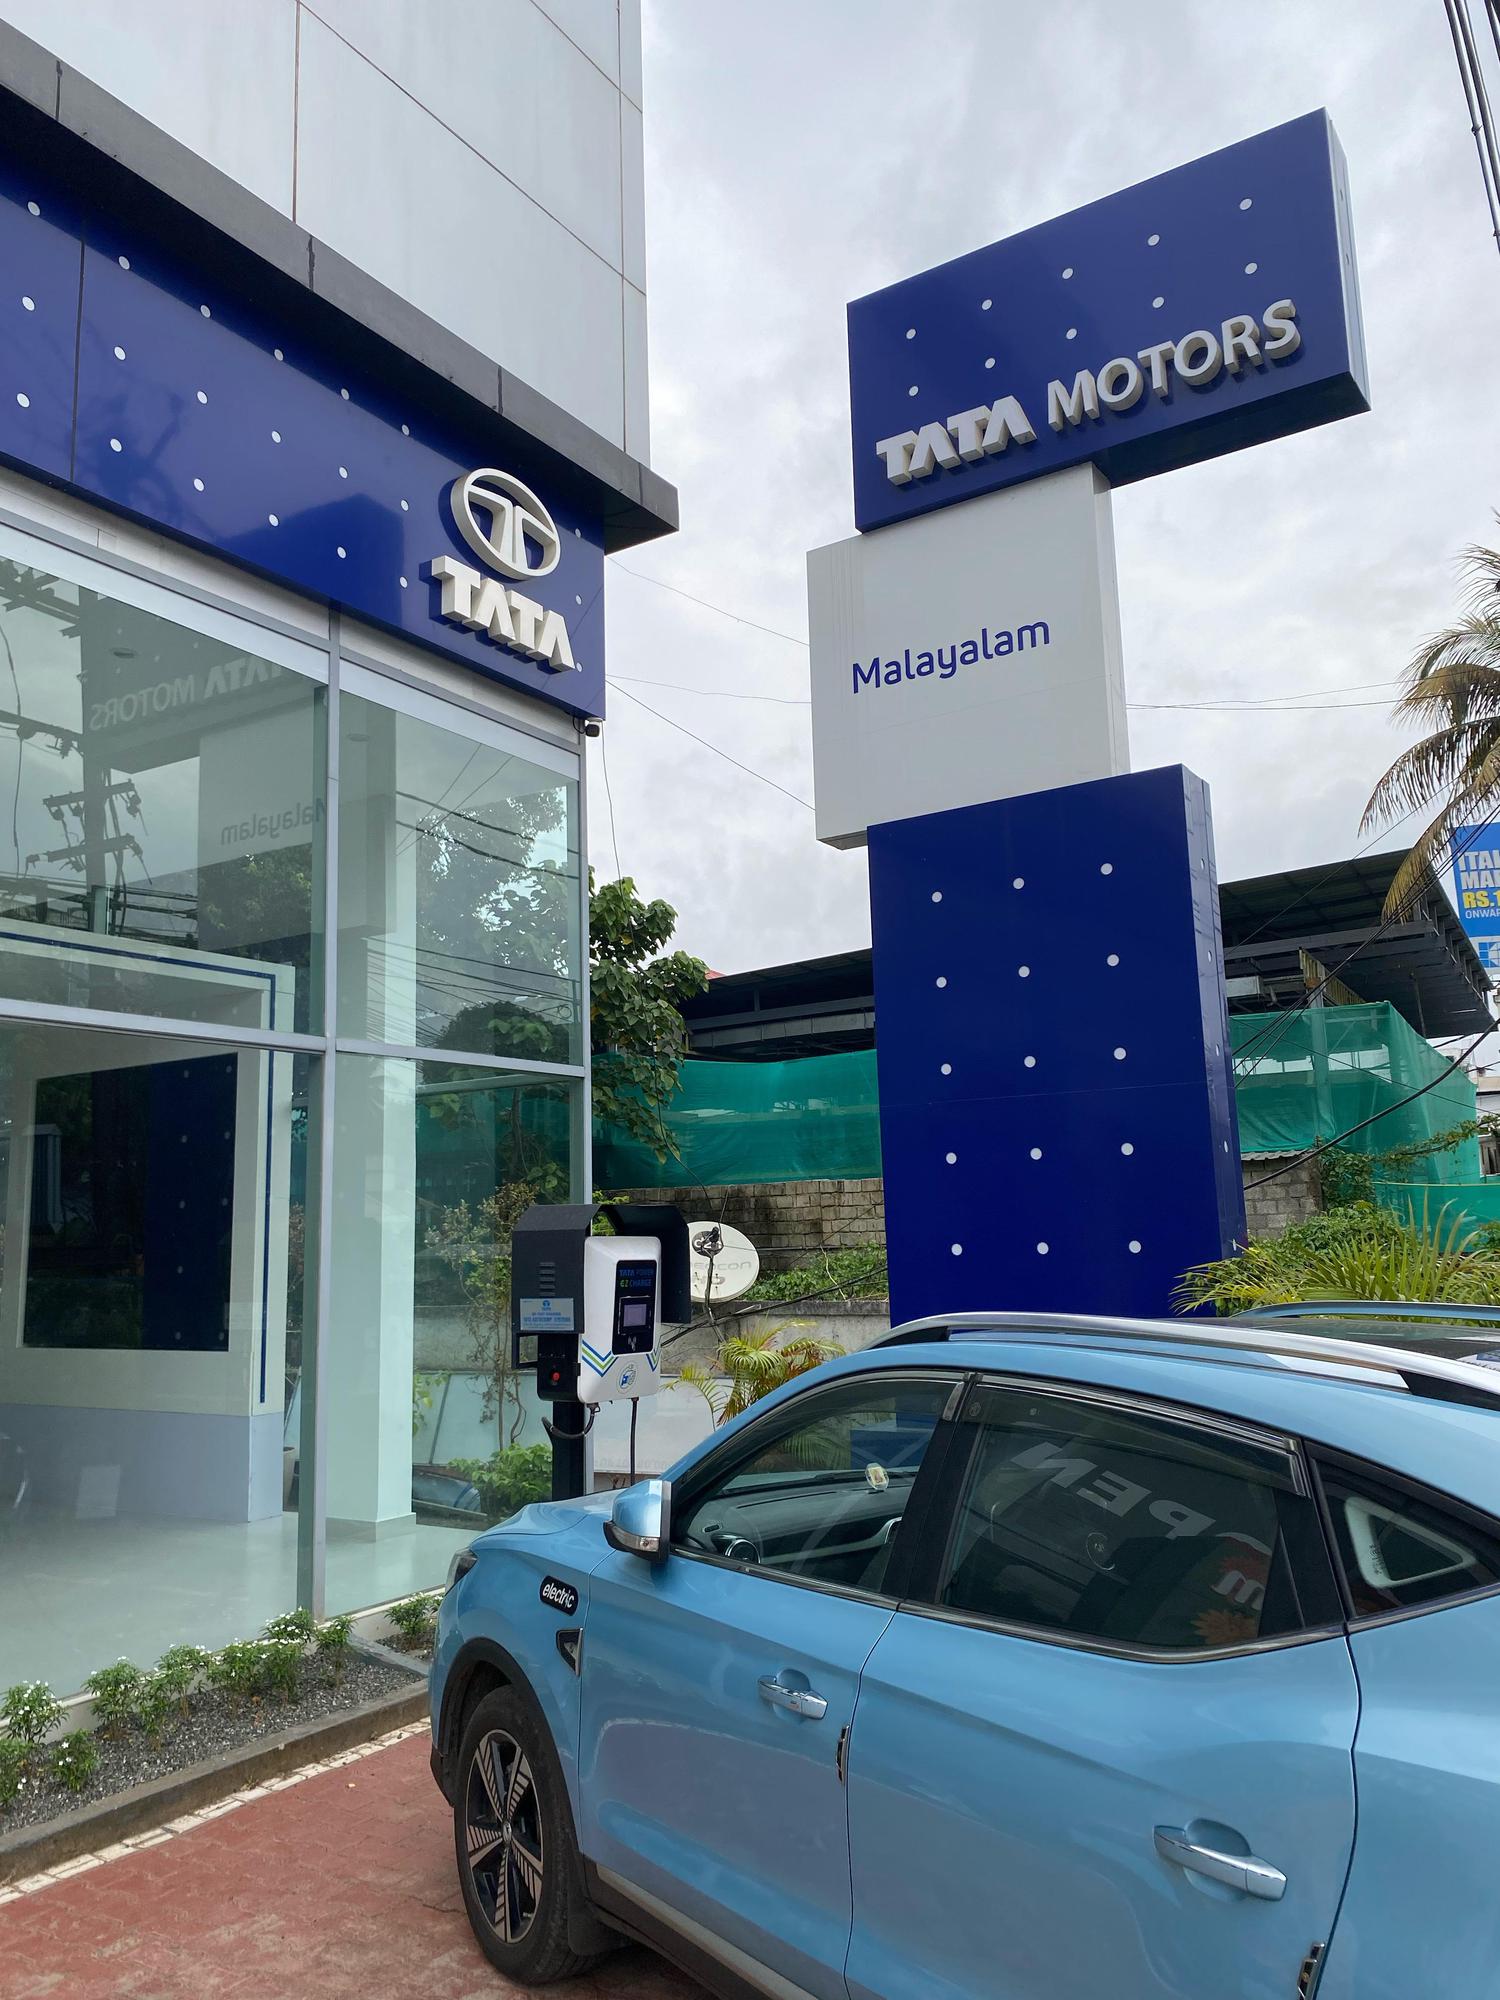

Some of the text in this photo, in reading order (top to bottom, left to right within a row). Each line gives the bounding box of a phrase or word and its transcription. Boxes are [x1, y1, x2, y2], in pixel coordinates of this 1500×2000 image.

[876, 298, 1301, 486] TATA MOTORS
[431, 554, 576, 673] TATA
[852, 620, 1051, 694] Malayalam
[542, 1582, 575, 1608] electric
